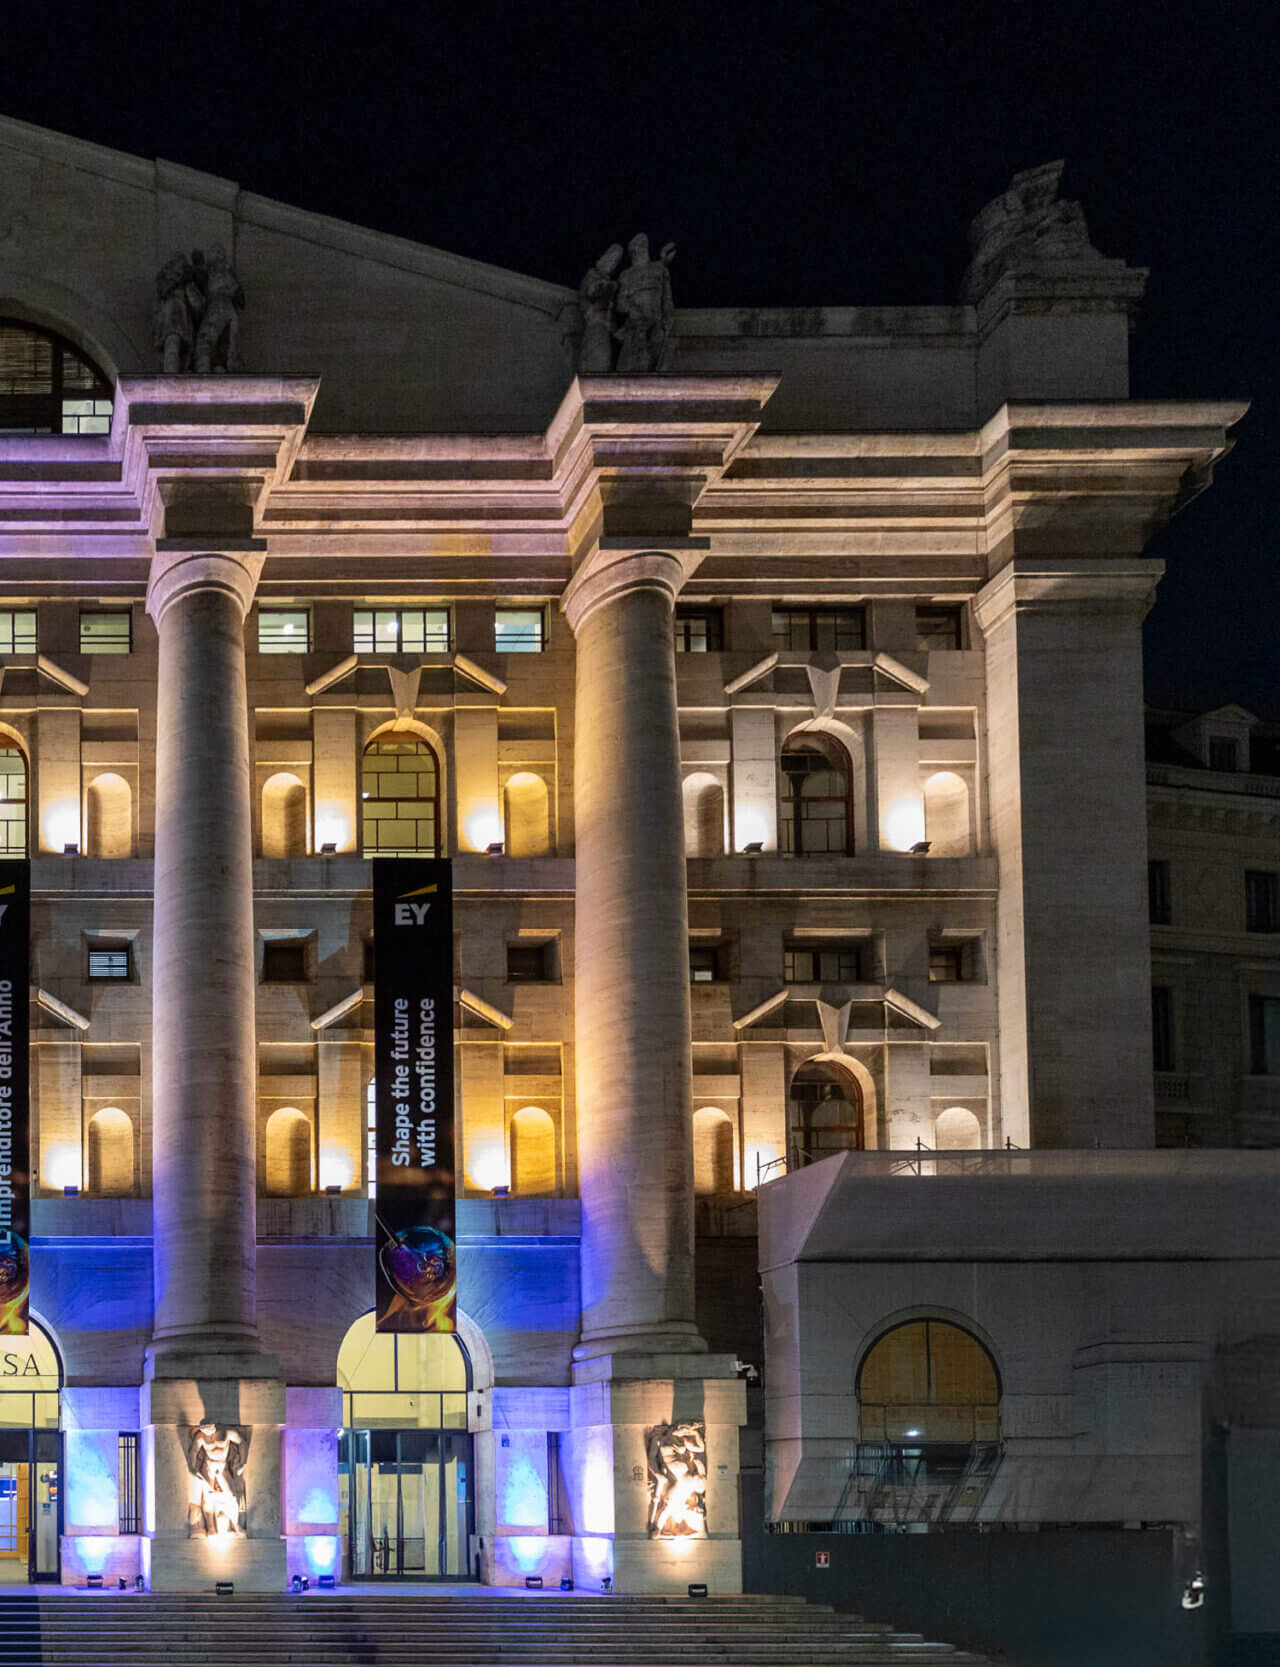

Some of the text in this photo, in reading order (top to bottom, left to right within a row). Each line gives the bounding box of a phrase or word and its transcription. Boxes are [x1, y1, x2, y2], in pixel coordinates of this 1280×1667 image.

[394, 903, 431, 925] EY
[390, 998, 414, 1167] Shape the future
[415, 998, 436, 1167] with confidence
